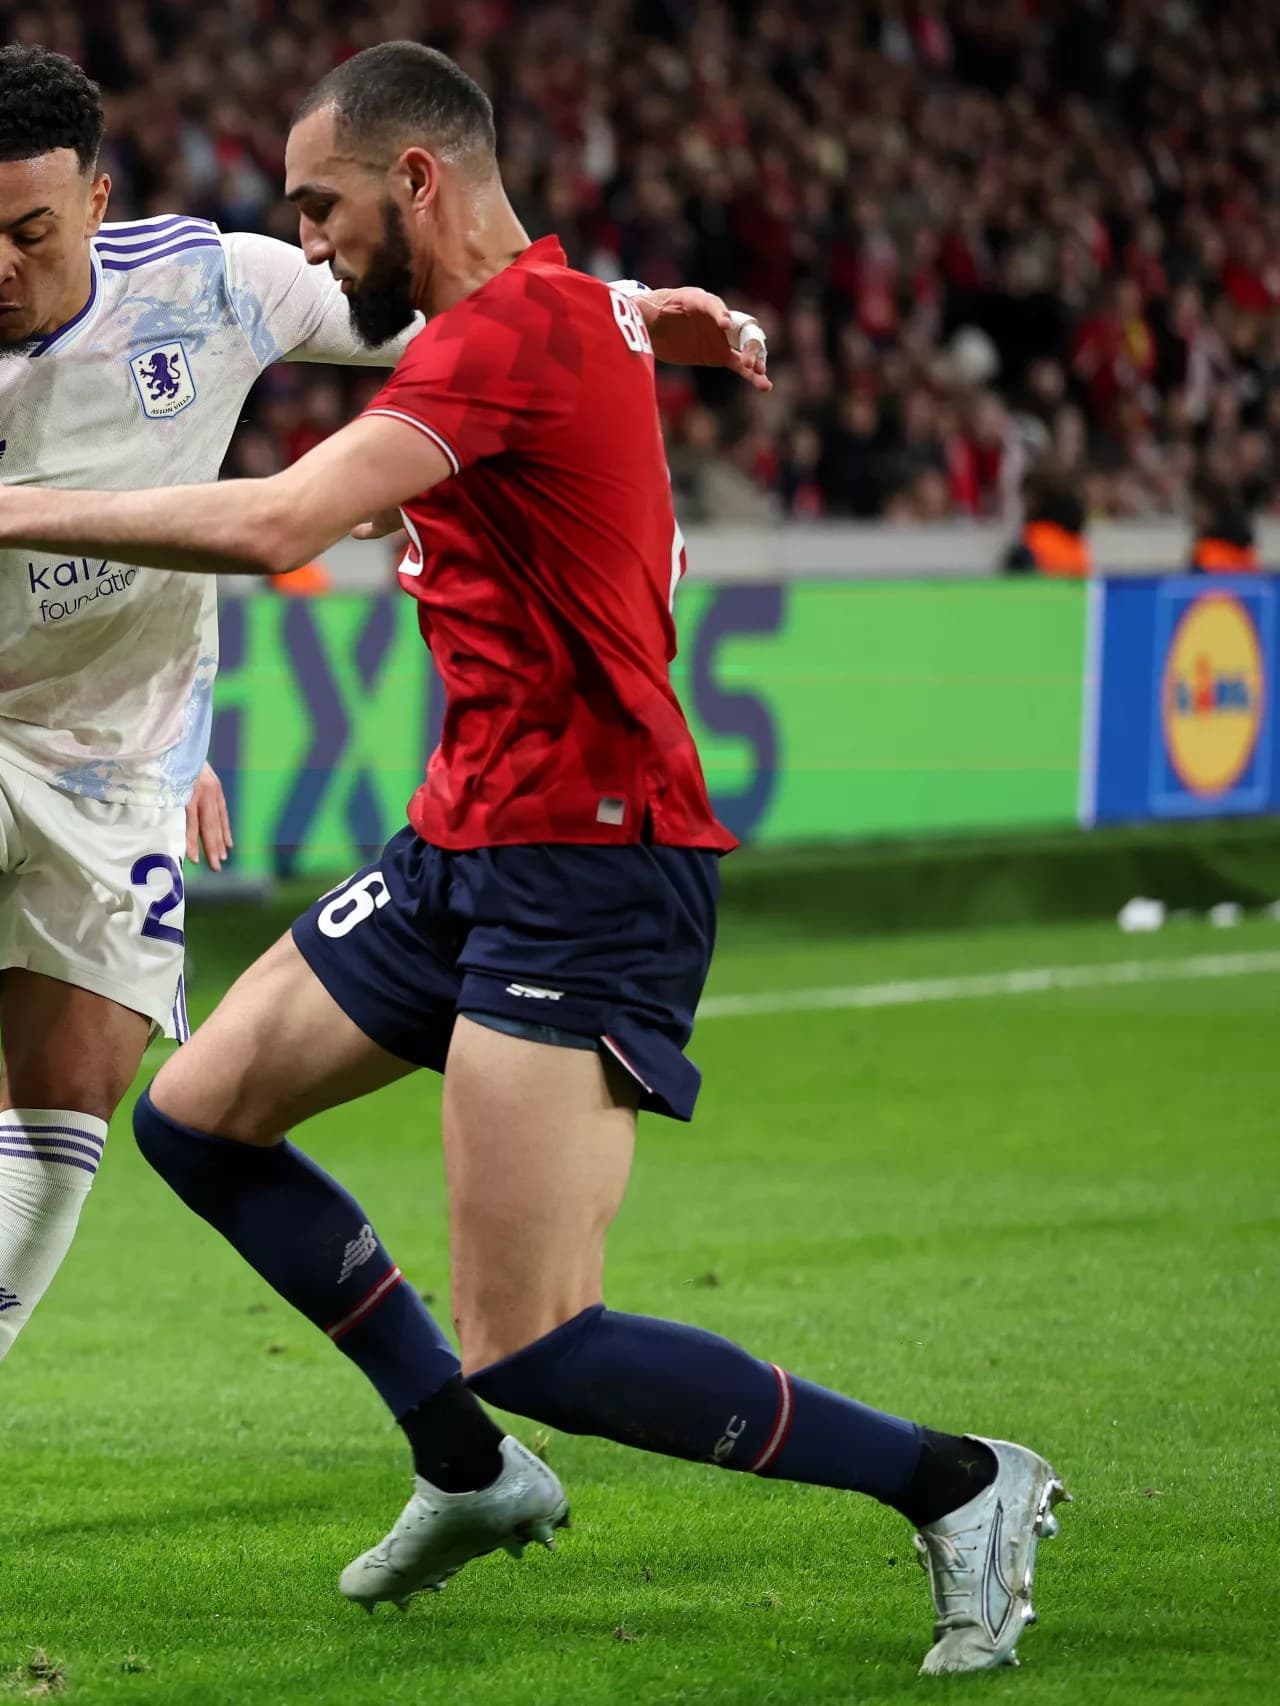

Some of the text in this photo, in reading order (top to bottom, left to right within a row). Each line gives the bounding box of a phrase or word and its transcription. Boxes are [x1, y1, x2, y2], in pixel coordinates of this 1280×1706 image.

[151, 406, 174, 415] ASTON
[174, 395, 191, 410] VILLA
[130, 853, 185, 947] 2
[317, 870, 392, 938] 6
[714, 1415, 747, 1462] SC
